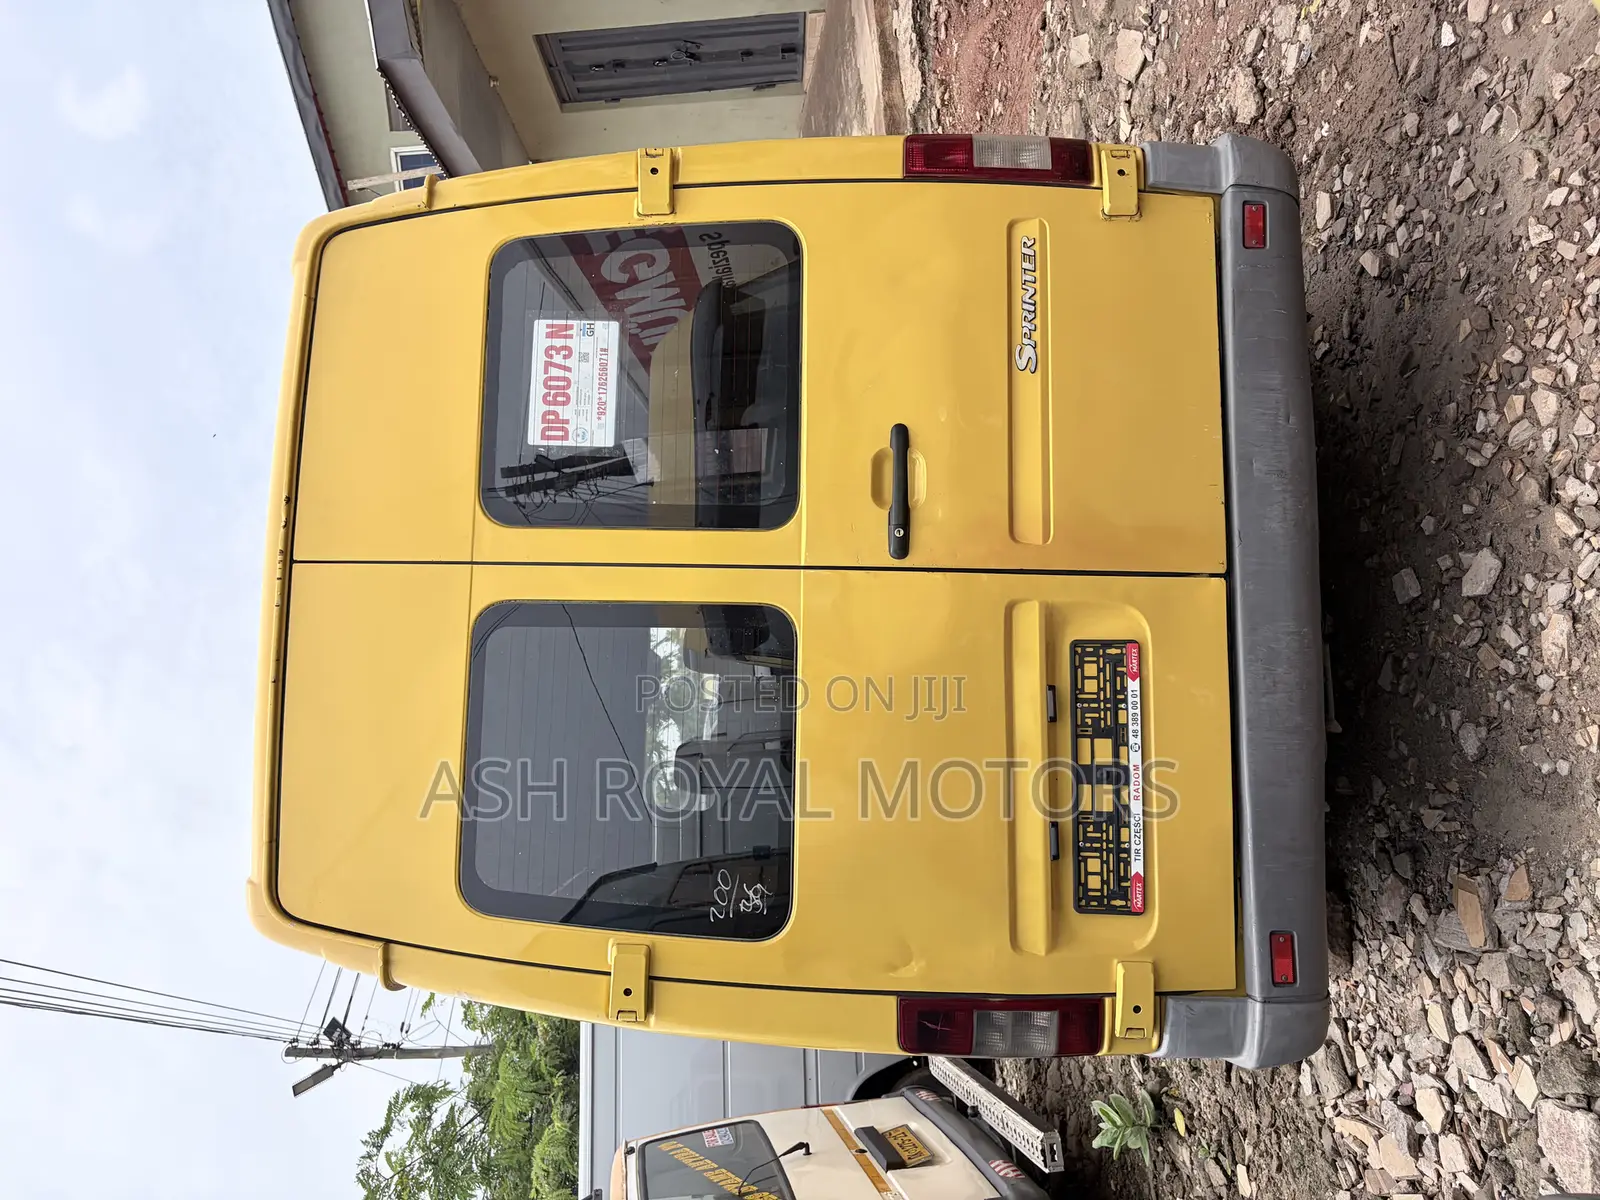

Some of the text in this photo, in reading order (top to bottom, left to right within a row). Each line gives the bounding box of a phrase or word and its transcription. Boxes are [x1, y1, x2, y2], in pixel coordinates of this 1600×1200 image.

[1015, 236, 1037, 374] SPRINTER
[586, 323, 594, 337] GH
[540, 324, 574, 441] DP 6073 N
[1130, 648, 1138, 673] MARTEX
[1130, 689, 1138, 699] 01
[1131, 701, 1139, 711] 00
[1131, 712, 1139, 727] 389
[1131, 729, 1139, 739] 48
[1133, 764, 1141, 801] RADOM
[1134, 848, 1142, 862] TIR
[1134, 882, 1142, 908] MARTEX
